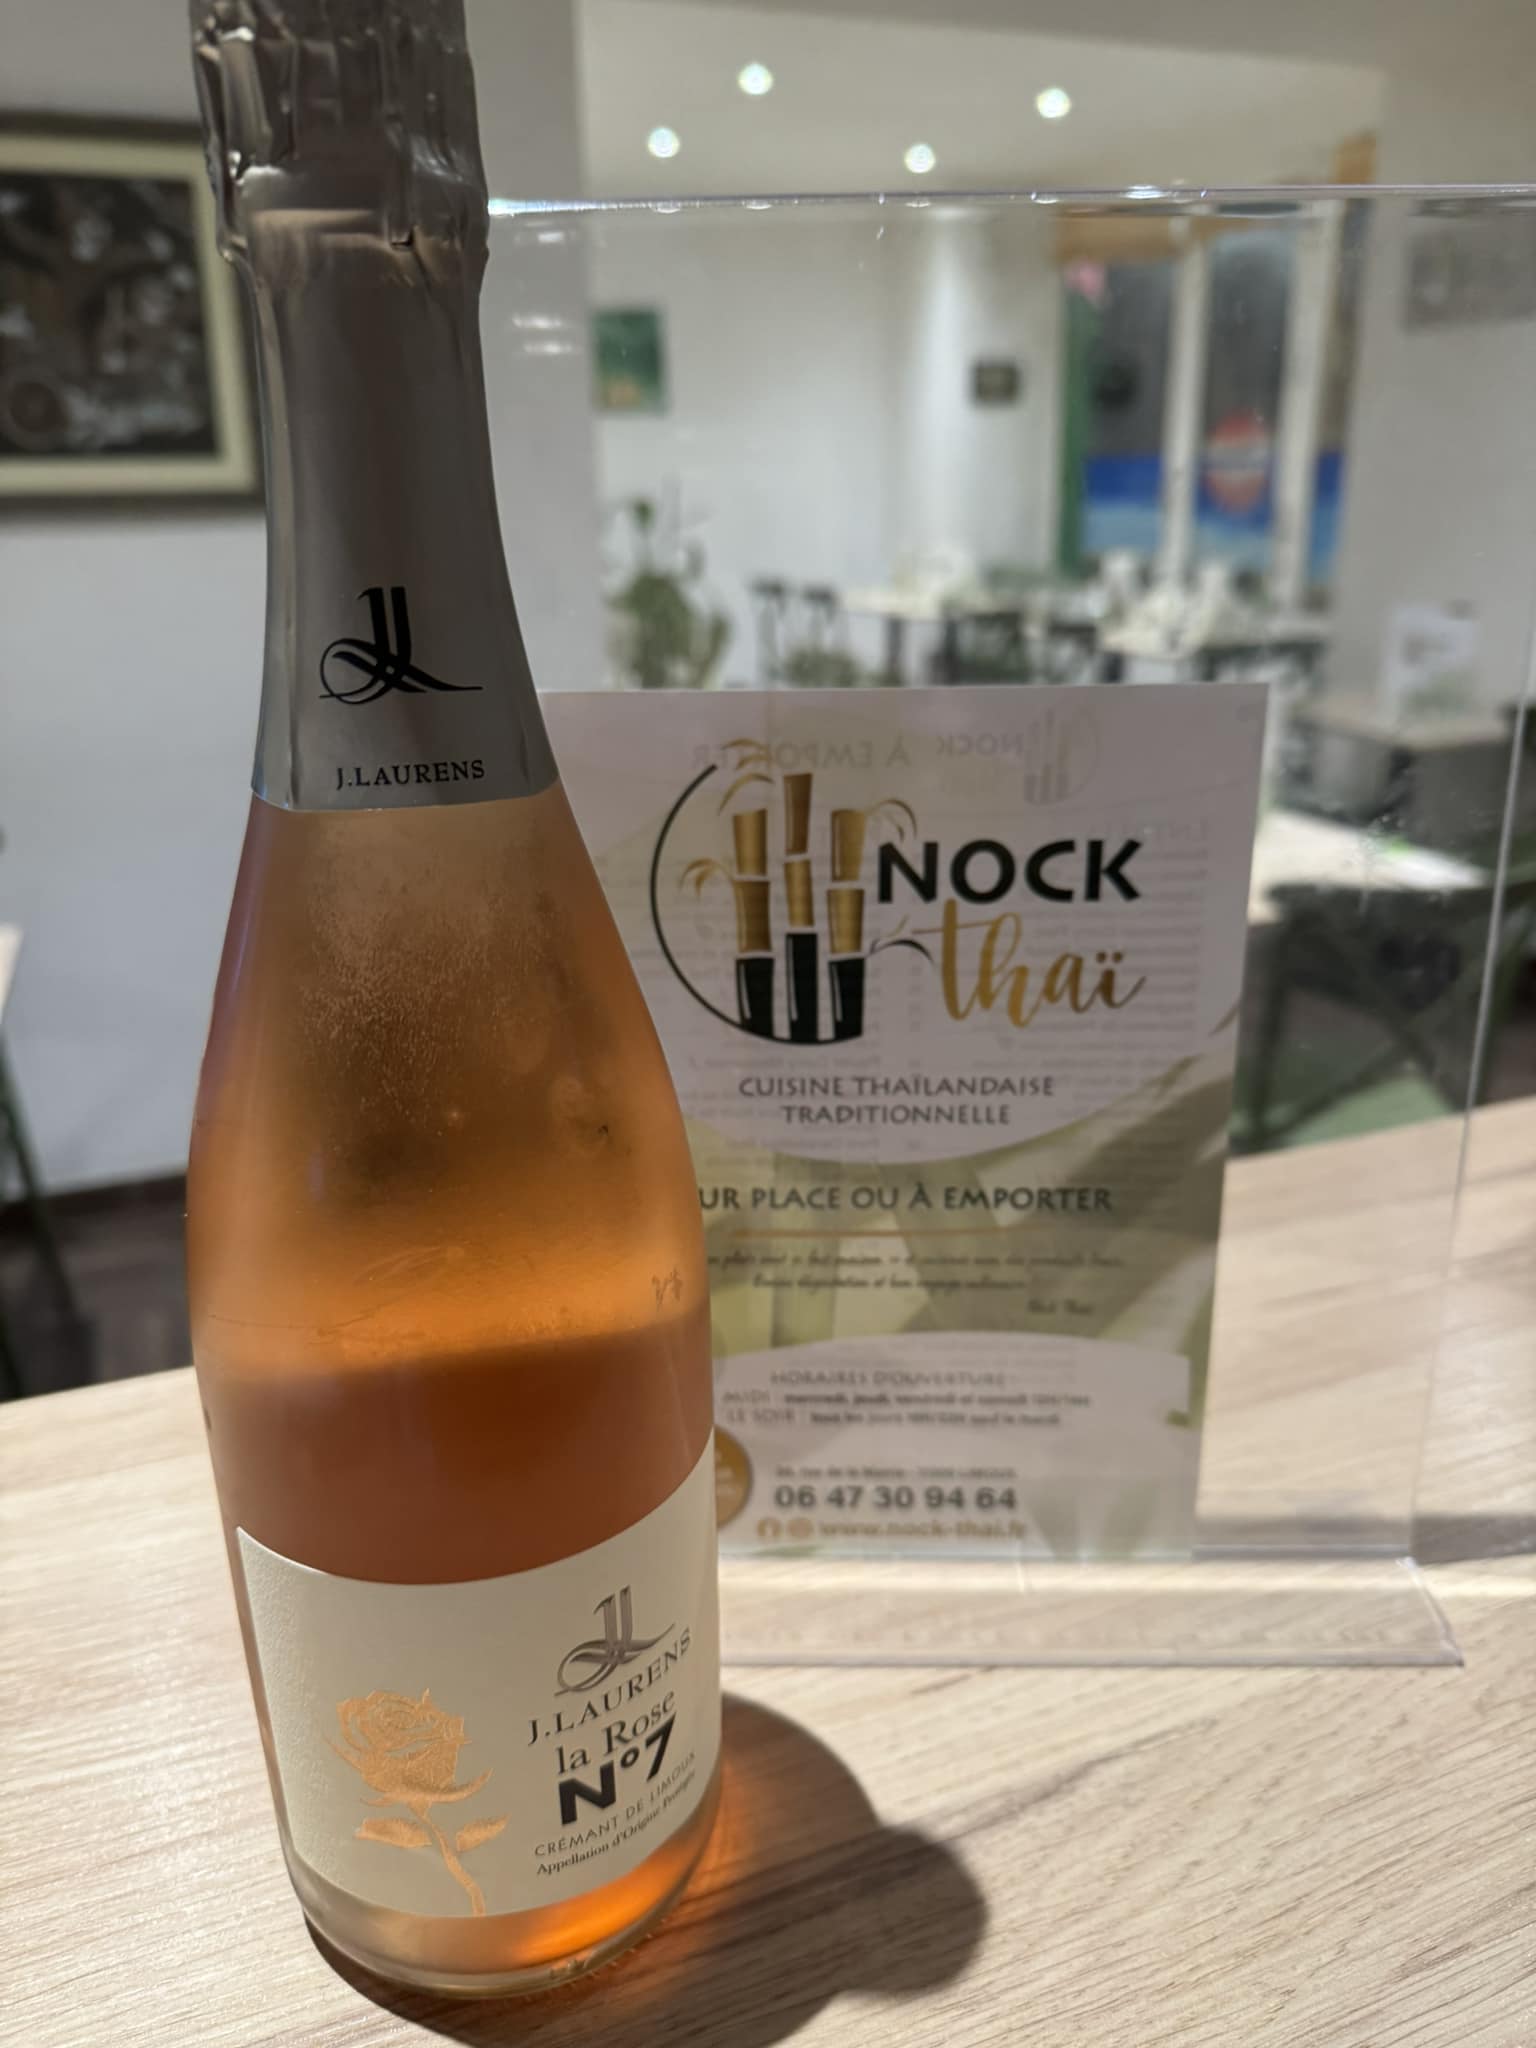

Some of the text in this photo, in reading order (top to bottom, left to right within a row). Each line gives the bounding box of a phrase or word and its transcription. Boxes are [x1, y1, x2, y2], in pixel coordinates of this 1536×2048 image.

[336, 759, 485, 790] J.LAURENS
[878, 839, 1142, 904] NOCK
[912, 898, 1146, 1028] thaï
[738, 1075, 1054, 1098] CUISINE THAÏLANDAISE
[780, 1104, 1011, 1125] TRADITIONNELLE
[698, 1181, 1113, 1211] UR PLACE OU À EMPORTER
[774, 1485, 1018, 1511] 06 47 30 94 64
[528, 1626, 692, 1747] J.LAURENS
[555, 1690, 675, 1775] la Rose
[534, 1816, 619, 1858] CRÉMANT
[625, 1802, 644, 1821] DE
[536, 1843, 610, 1876] Appellation
